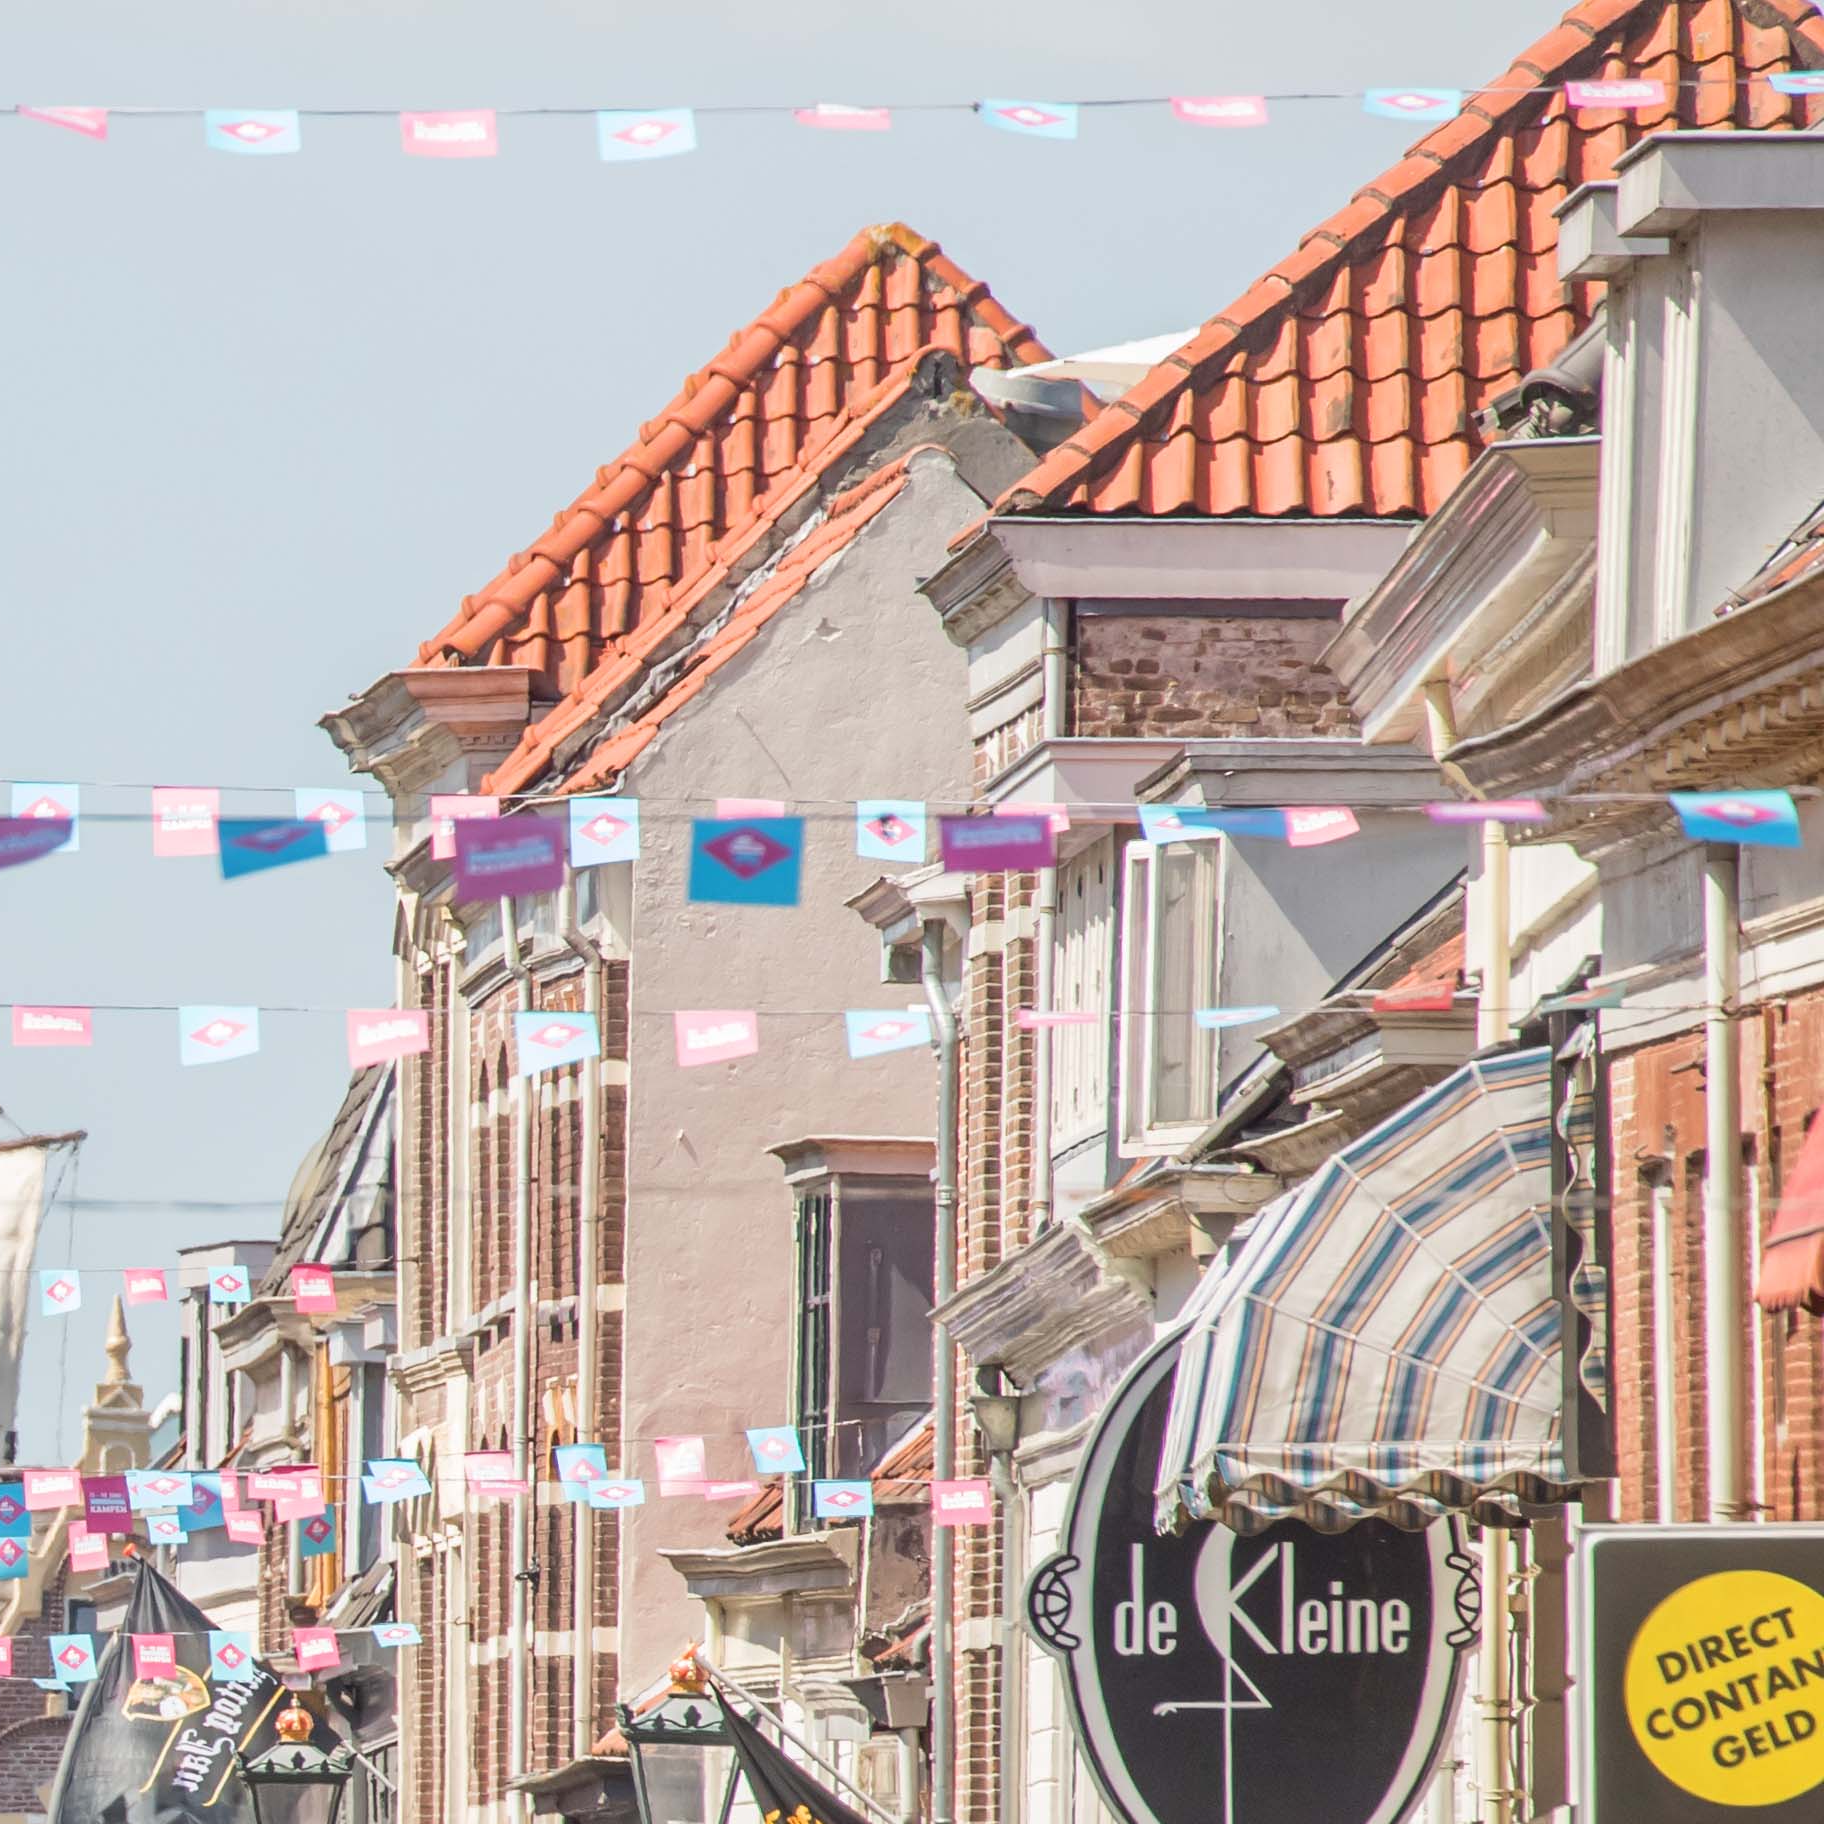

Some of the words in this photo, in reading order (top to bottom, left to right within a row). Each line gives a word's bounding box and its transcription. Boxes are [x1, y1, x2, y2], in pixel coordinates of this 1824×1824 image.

[1113, 1542, 1178, 1655] de
[1656, 1607, 1796, 1684] DIRECT
[1712, 1710, 1817, 1768] GELD
